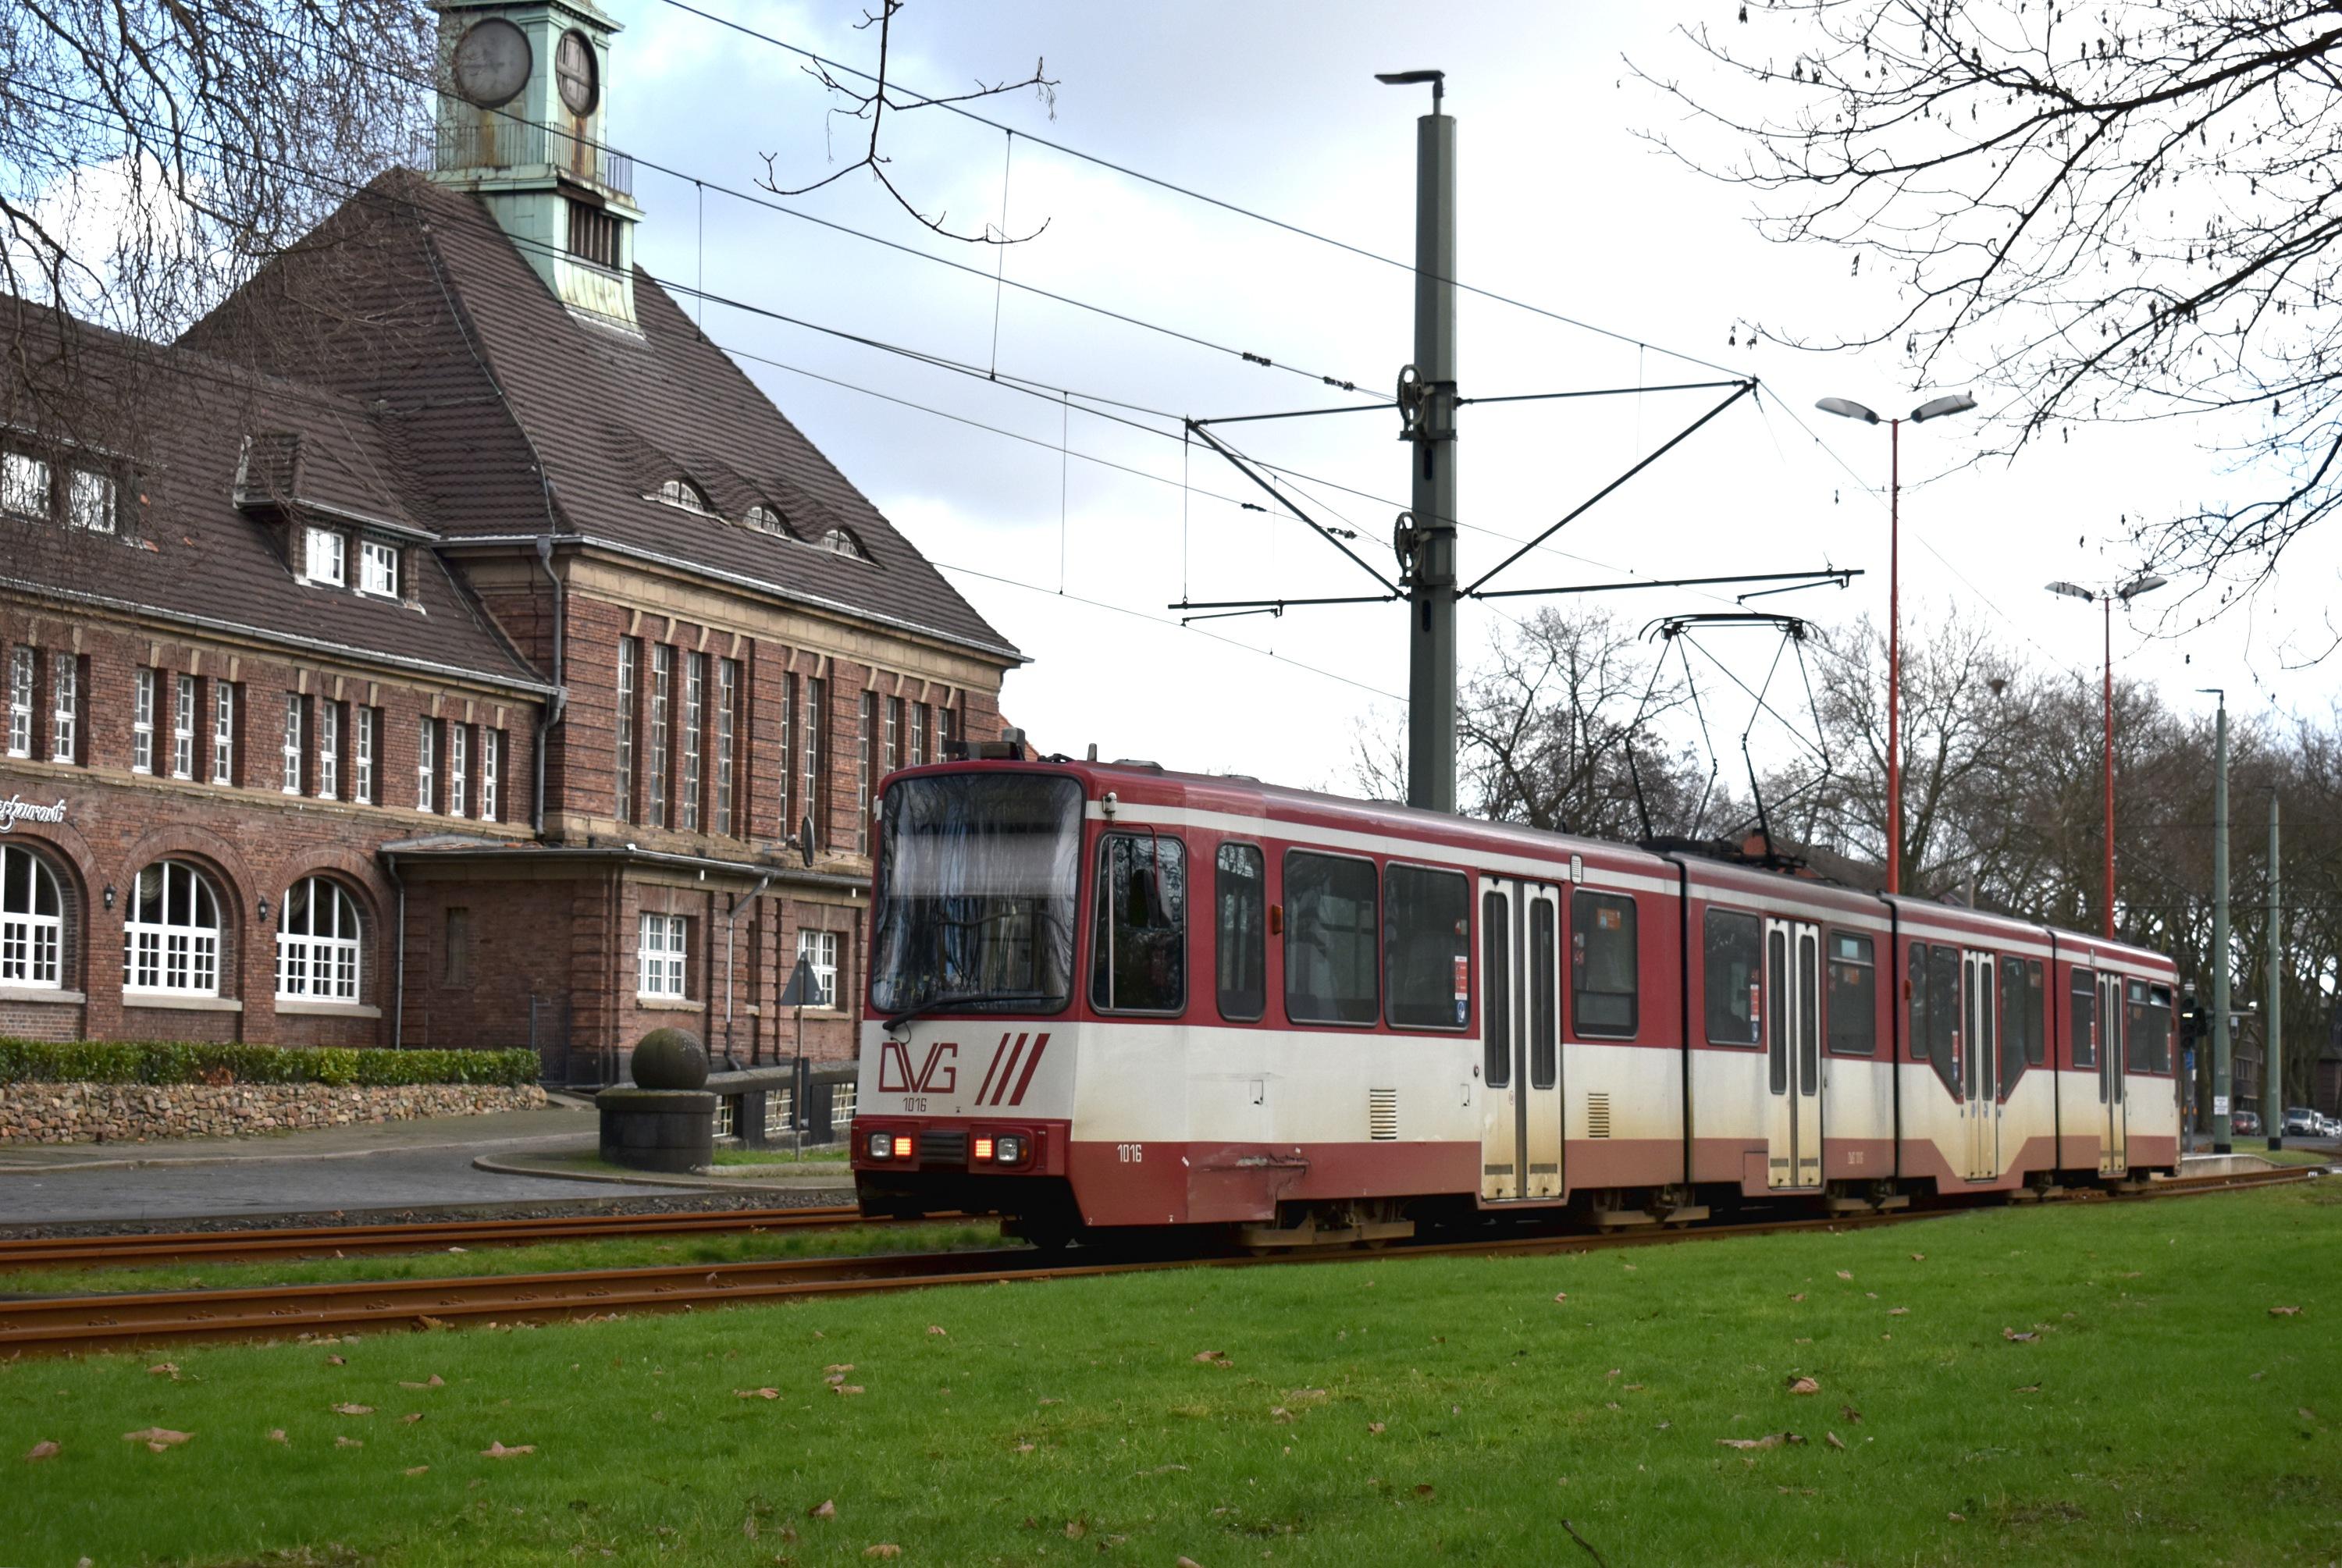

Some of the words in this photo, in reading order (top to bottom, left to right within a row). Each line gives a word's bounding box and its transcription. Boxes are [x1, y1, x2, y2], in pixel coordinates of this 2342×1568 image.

[878, 1042, 959, 1093] DVG
[903, 1097, 927, 1112] 1016
[1117, 1143, 1142, 1163] 1016
